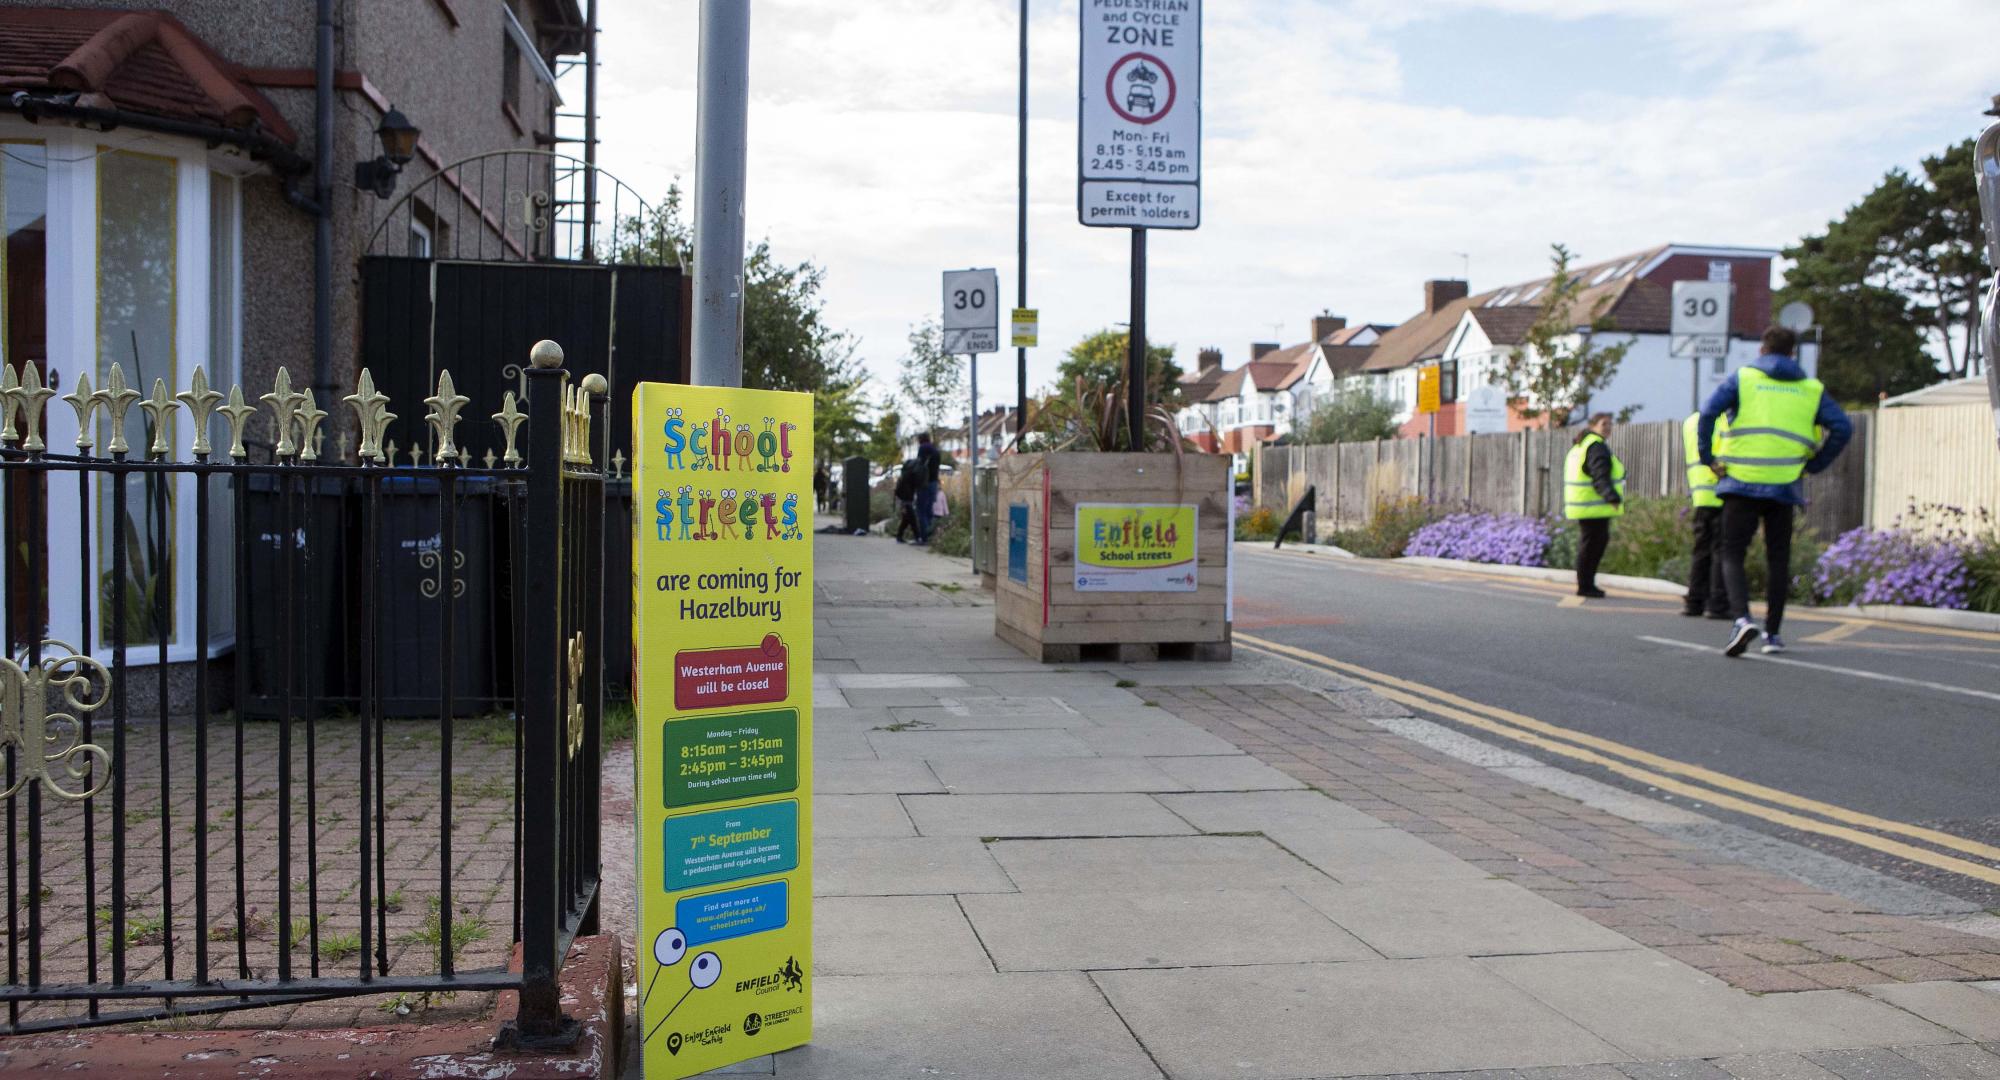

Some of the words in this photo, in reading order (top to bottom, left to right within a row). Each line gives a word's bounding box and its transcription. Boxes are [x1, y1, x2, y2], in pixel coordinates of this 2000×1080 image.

[1093, 0, 1190, 11] PEDESTRIAN
[1103, 12, 1127, 23] and
[1132, 11, 1180, 26] CYCLE
[1107, 26, 1174, 47] ZONE
[1152, 132, 1170, 144] Fri
[1096, 144, 1125, 156] 8.15
[1136, 145, 1163, 158] 9.15
[1166, 149, 1186, 159] am
[1091, 159, 1124, 171] 2.45
[1135, 160, 1166, 173] 3.45
[1169, 163, 1190, 175] pm
[1106, 190, 1152, 204] Except
[1156, 192, 1176, 204] for
[1091, 206, 1137, 218] permit
[953, 288, 986, 310] 30
[1683, 298, 1718, 318] 30
[966, 340, 994, 351] ENDS
[664, 411, 795, 468] School
[655, 487, 802, 536] streets
[1094, 516, 1178, 547] Enfield
[1100, 551, 1134, 561] School
[1136, 551, 1172, 561] streets
[657, 574, 690, 592] are
[697, 567, 769, 594] coming
[774, 566, 802, 594] for
[680, 596, 782, 621] Hazelbury
[681, 664, 742, 678] Westerham
[745, 661, 784, 673] Avenue
[696, 682, 718, 695] will
[721, 681, 734, 692] be
[737, 677, 769, 691] closed
[706, 730, 732, 739] Monday
[738, 726, 759, 736] Friday
[681, 743, 726, 759] 8:15am
[740, 737, 783, 752] 9:15am
[680, 761, 726, 776] 2:45pm
[740, 753, 784, 769] 3:45pm
[687, 779, 710, 789] During
[711, 777, 731, 787] school
[732, 775, 747, 783] term
[747, 773, 762, 782] time
[763, 771, 777, 781] only
[725, 820, 741, 828] From
[690, 834, 706, 850] 7th
[709, 827, 772, 848] September
[684, 853, 720, 865] Westerham
[721, 850, 744, 860] Avenue
[745, 847, 758, 856] will
[758, 844, 780, 854] become
[689, 862, 723, 876] pedestrian
[723, 860, 735, 869] and
[736, 857, 753, 868] cycle
[753, 855, 767, 865] only
[767, 853, 781, 862] zone
[703, 902, 720, 913] Find
[720, 900, 732, 909] out
[733, 898, 750, 907] more
[751, 896, 760, 904] at
[735, 973, 780, 993] ENFIELD
[755, 984, 780, 996] Council
[764, 1005, 804, 1022] STREETSPACE
[772, 1017, 790, 1027] LONDON
[684, 1030, 704, 1044] Enjoy
[704, 1024, 732, 1038] Enfield
[701, 1035, 723, 1046] Safely
